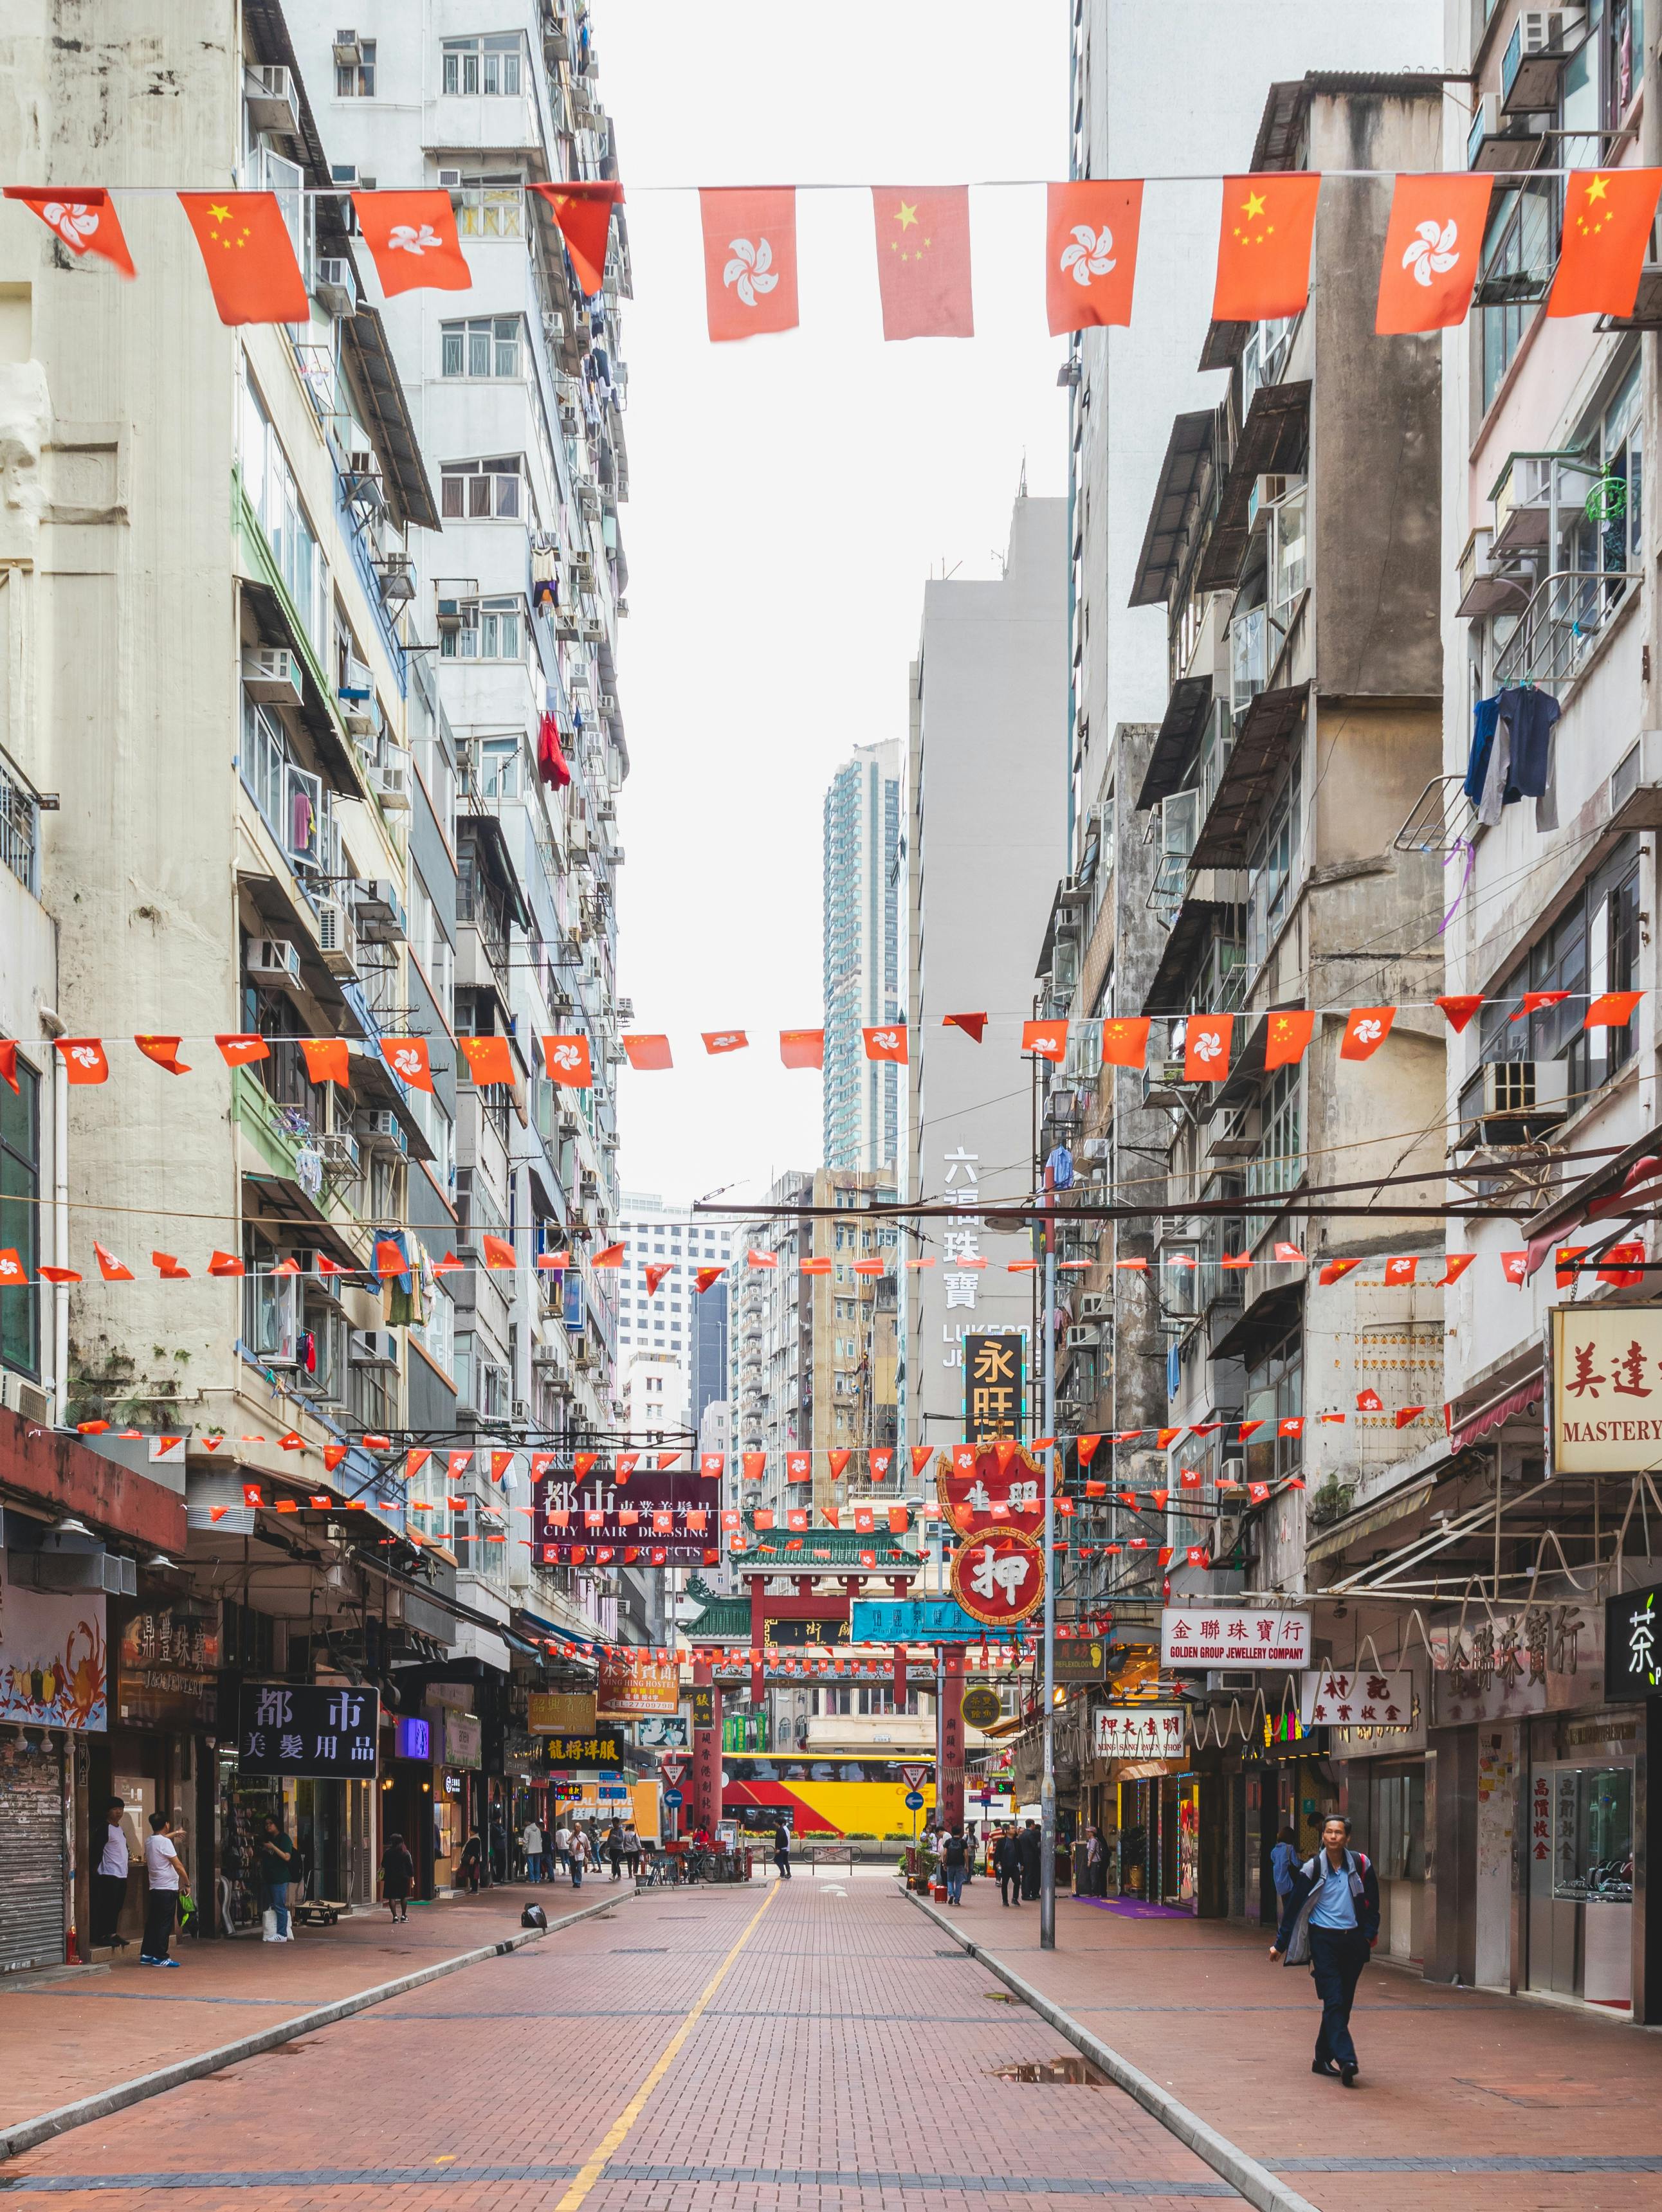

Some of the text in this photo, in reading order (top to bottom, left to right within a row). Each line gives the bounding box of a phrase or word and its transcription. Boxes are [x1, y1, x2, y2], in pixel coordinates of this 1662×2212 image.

[943, 1146, 980, 1310] 六福珠寶
[1566, 1339, 1662, 1399] 美達
[1562, 1420, 1662, 1442] MASTERY
[542, 1480, 618, 1516] 都市
[543, 1525, 709, 1538] CITY HAIR DRESSING
[970, 1544, 1030, 1606] 押
[1171, 1618, 1305, 1642] 金聯珠寶行
[1629, 1608, 1656, 1673] 茶
[1170, 1646, 1304, 1660] GOLDEN GROUP JEWELLERY COMPANY
[1447, 1605, 1585, 1698] 金聯珠寶行
[625, 1679, 644, 1687] HING
[646, 1680, 675, 1689] HOSTEL
[1322, 1674, 1391, 1700] 材記
[254, 1687, 365, 1732] 都市
[608, 1700, 673, 1710] TEL:27709798
[1315, 1705, 1402, 1722] 專業收金
[243, 1732, 374, 1761] 美髮用品
[548, 1739, 619, 1761] 龍將洋服
[1163, 1743, 1182, 1752] SHOP
[1533, 1777, 1551, 1861] 高價收金
